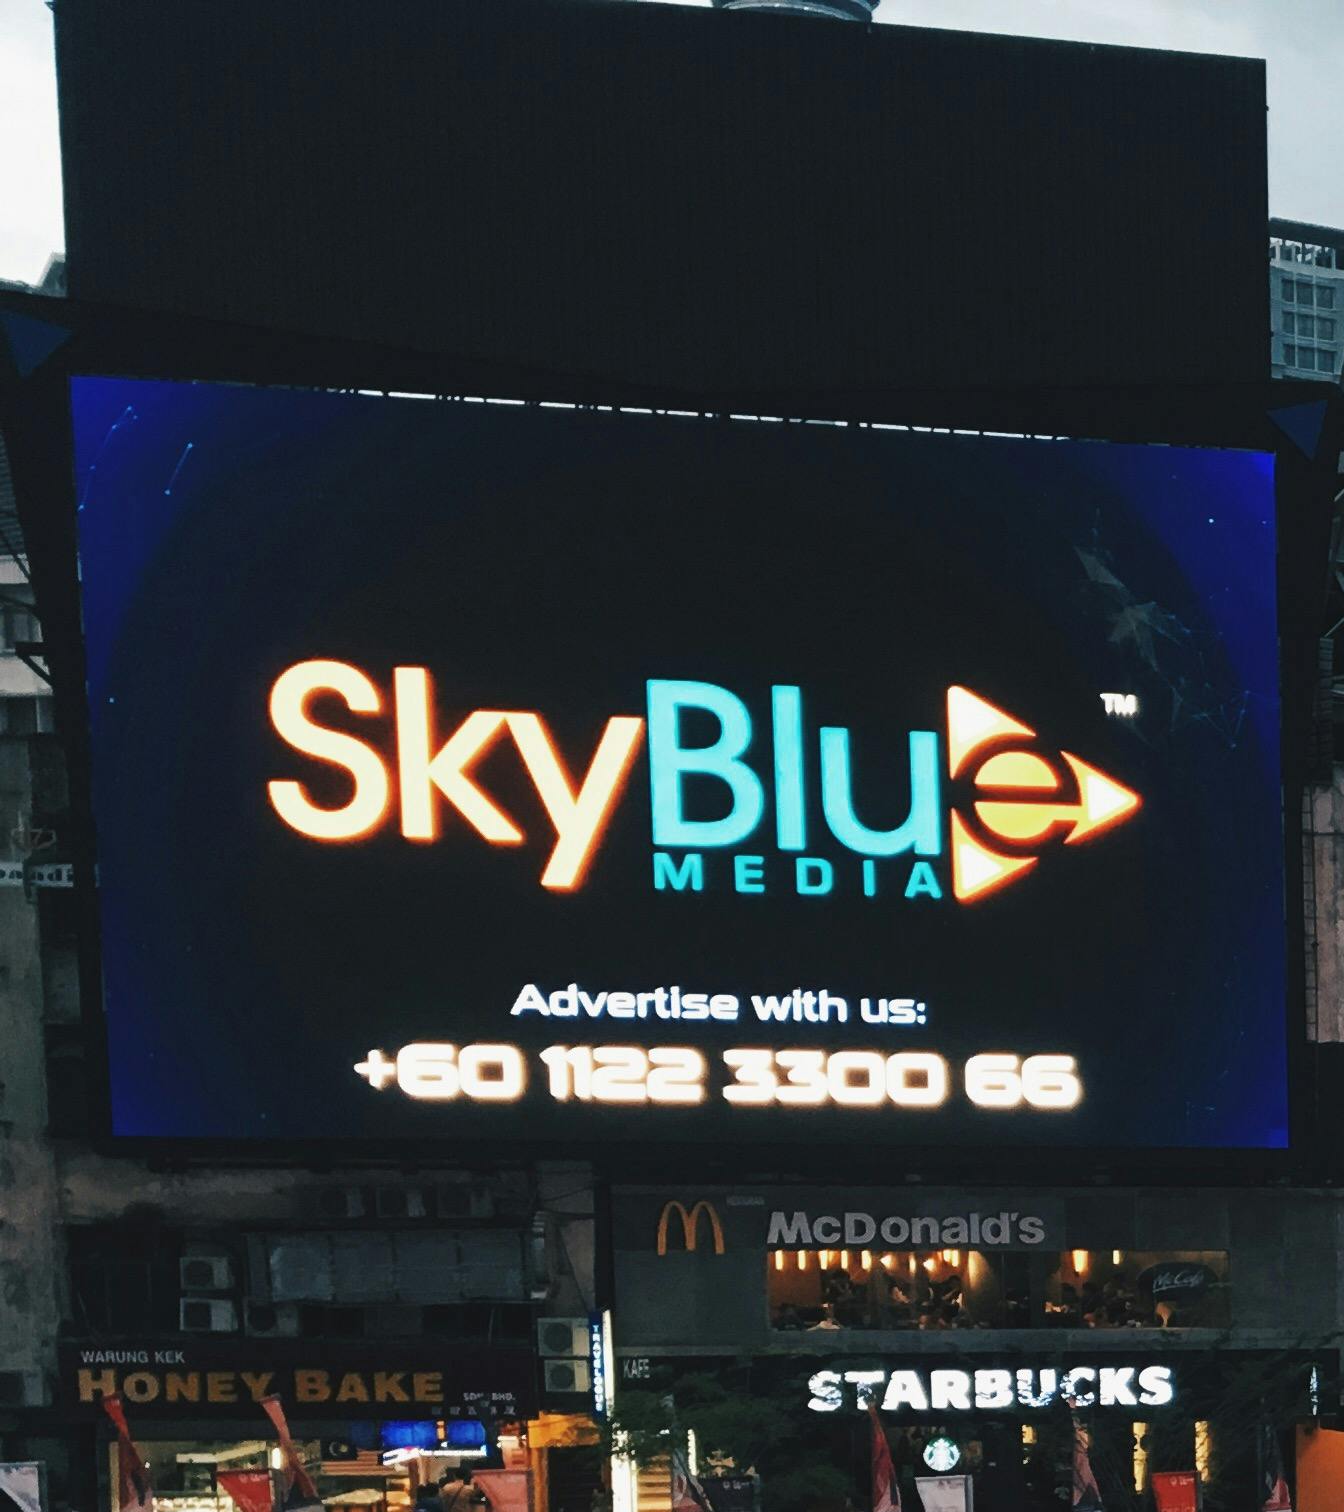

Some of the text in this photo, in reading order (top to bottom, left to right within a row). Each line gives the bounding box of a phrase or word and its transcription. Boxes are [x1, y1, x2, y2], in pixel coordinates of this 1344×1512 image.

[266, 656, 1143, 904] SkyBlue
[652, 852, 943, 899] MEDIA
[510, 982, 927, 1025] Advertise with us:
[352, 1043, 1083, 1109] +60 1122 3300 66
[766, 1210, 1046, 1245] McDonald's
[80, 1350, 185, 1364] WARUNG KEK
[78, 1369, 444, 1403] HONEY BAKE
[807, 1365, 1174, 1412] STARBUCKS
